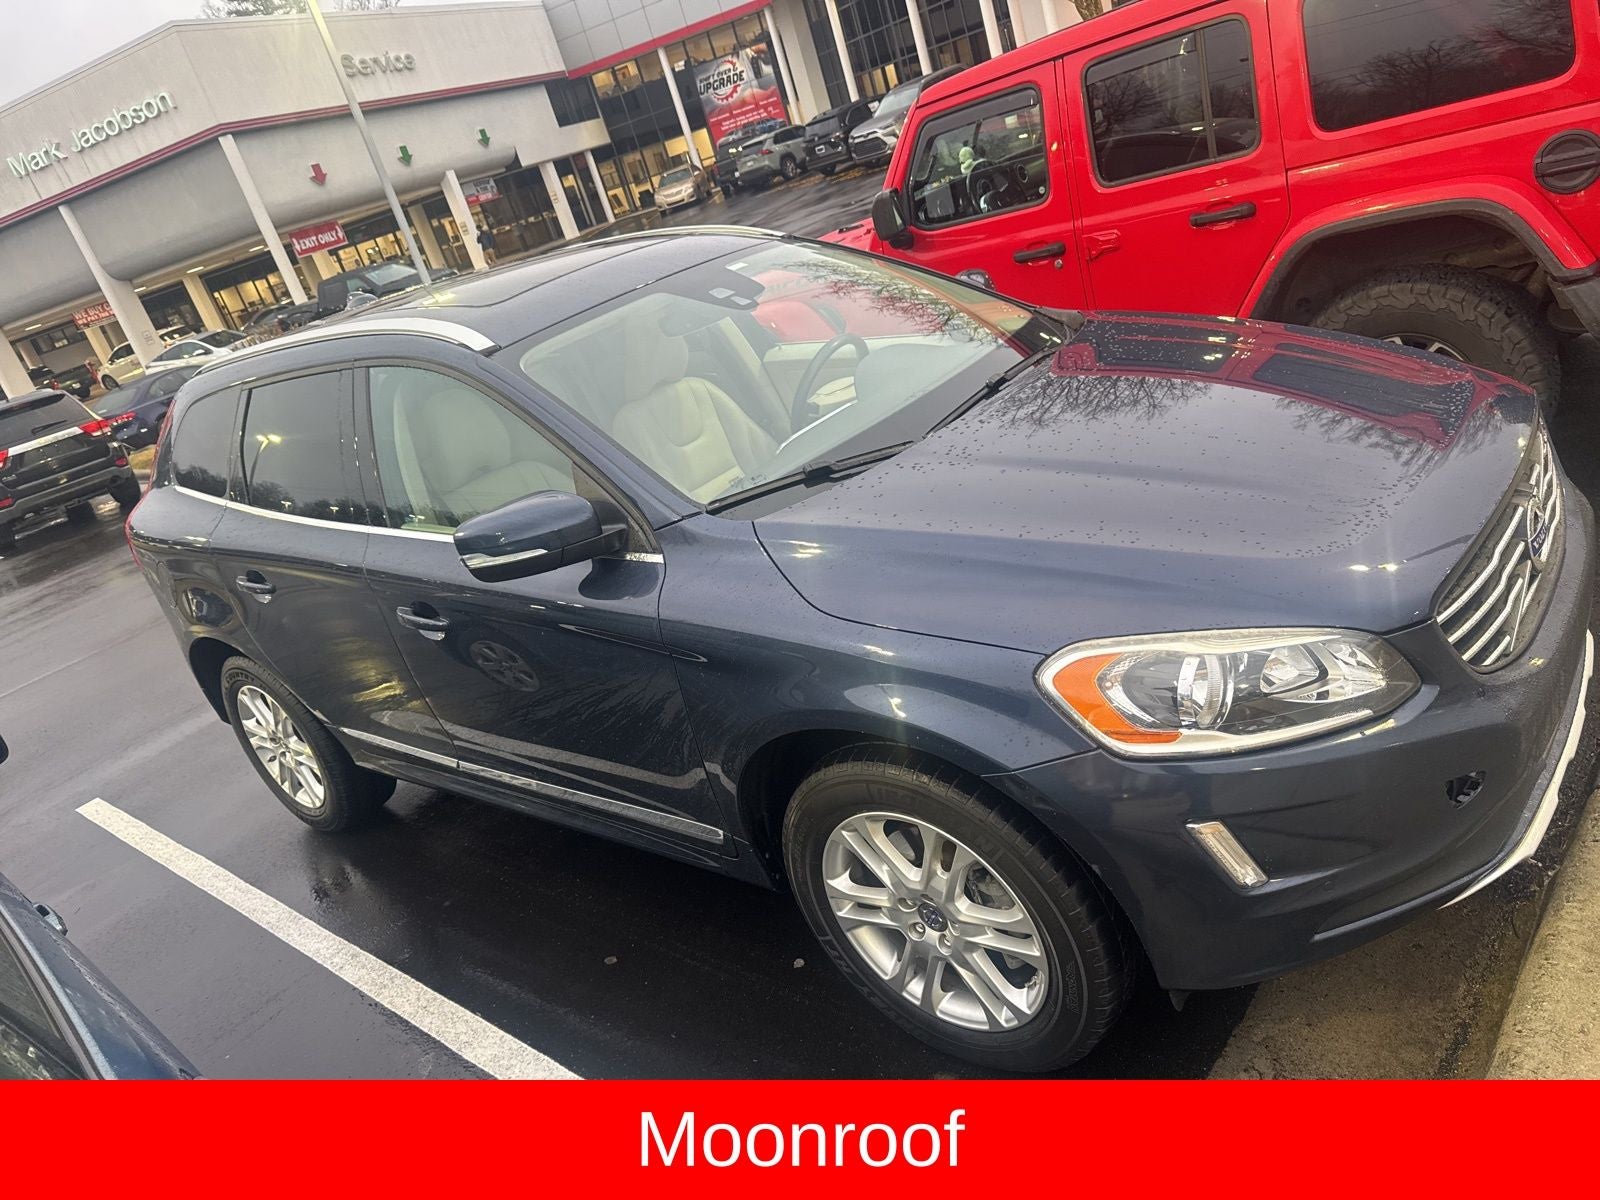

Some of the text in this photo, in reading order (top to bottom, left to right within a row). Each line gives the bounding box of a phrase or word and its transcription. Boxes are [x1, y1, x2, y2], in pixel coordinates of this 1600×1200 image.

[341, 50, 416, 77] Service
[716, 68, 731, 77] OVER
[699, 70, 745, 95] UPGRADE
[7, 92, 177, 178] Mark Jacobson
[300, 230, 338, 250] EXIT ONLY
[71, 311, 87, 320] WE
[86, 305, 103, 316] BUY
